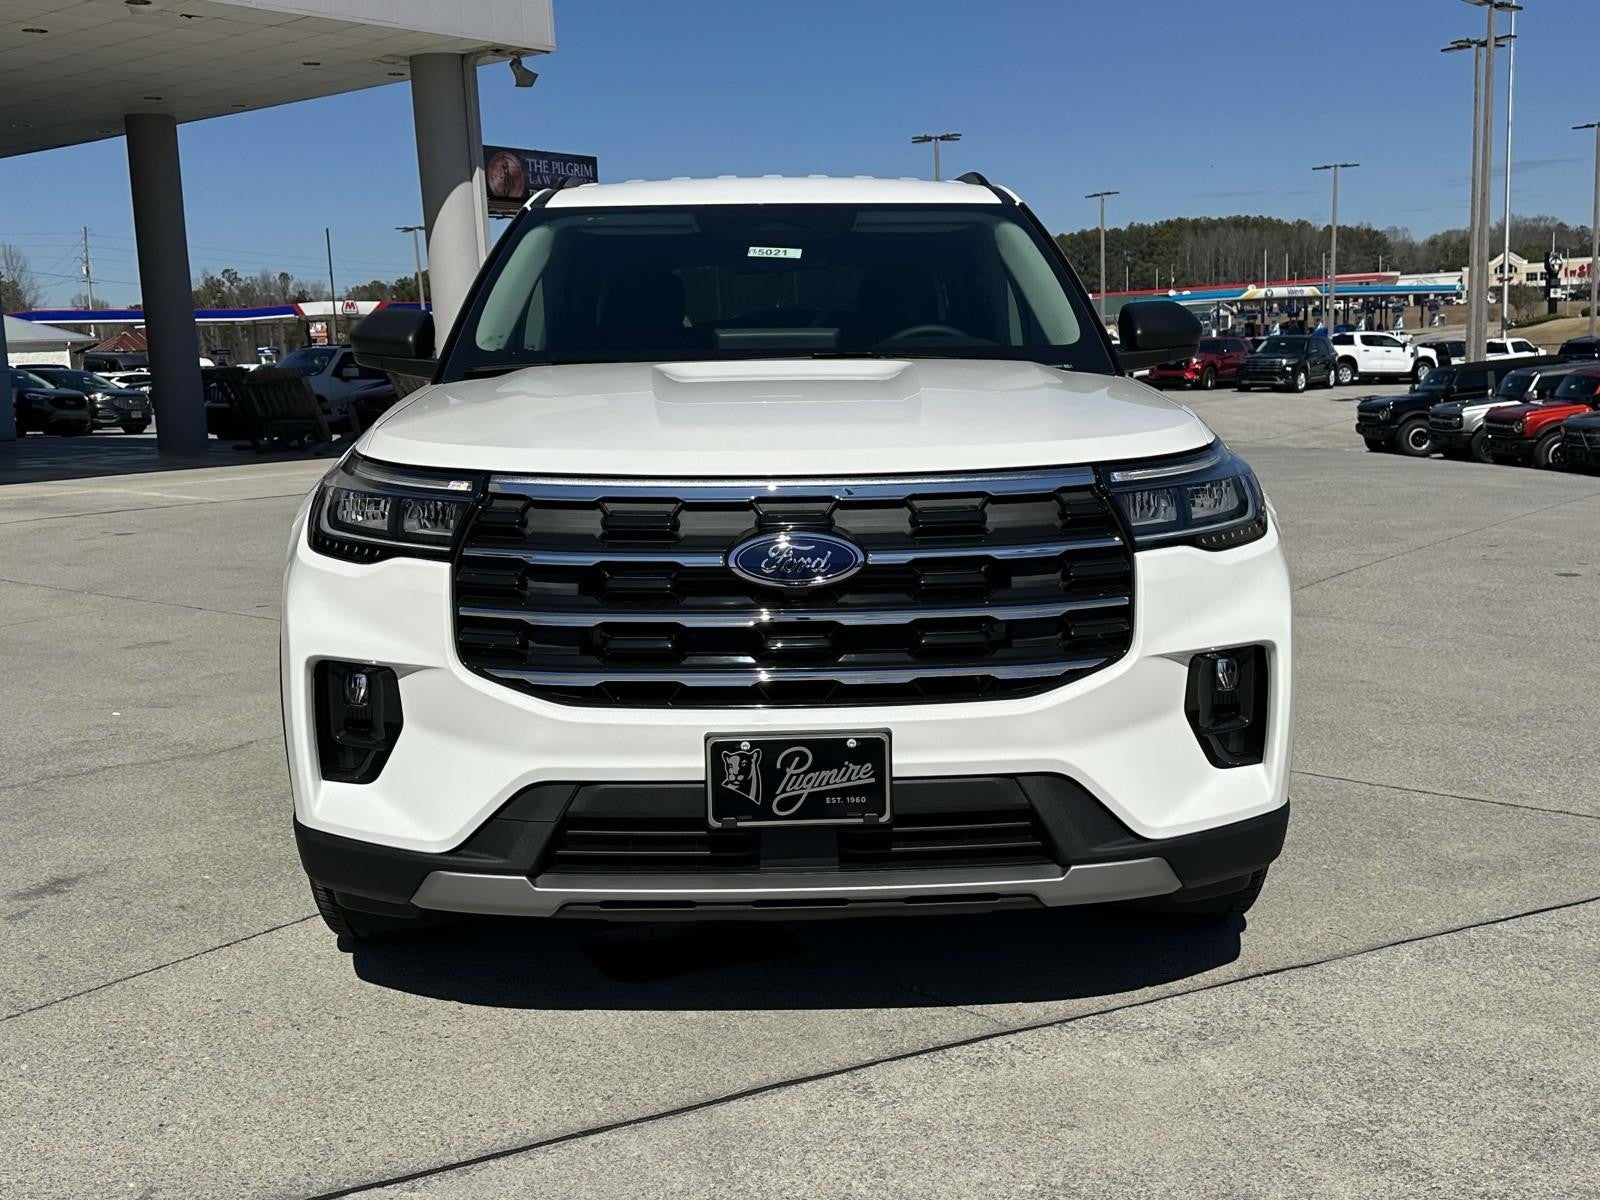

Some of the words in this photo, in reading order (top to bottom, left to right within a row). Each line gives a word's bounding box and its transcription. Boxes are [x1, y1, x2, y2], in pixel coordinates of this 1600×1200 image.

[526, 159, 549, 173] THE
[551, 161, 593, 177] PILGRIM
[528, 173, 551, 184] LAW
[761, 542, 832, 573] Ford
[772, 746, 875, 816] Pugmire
